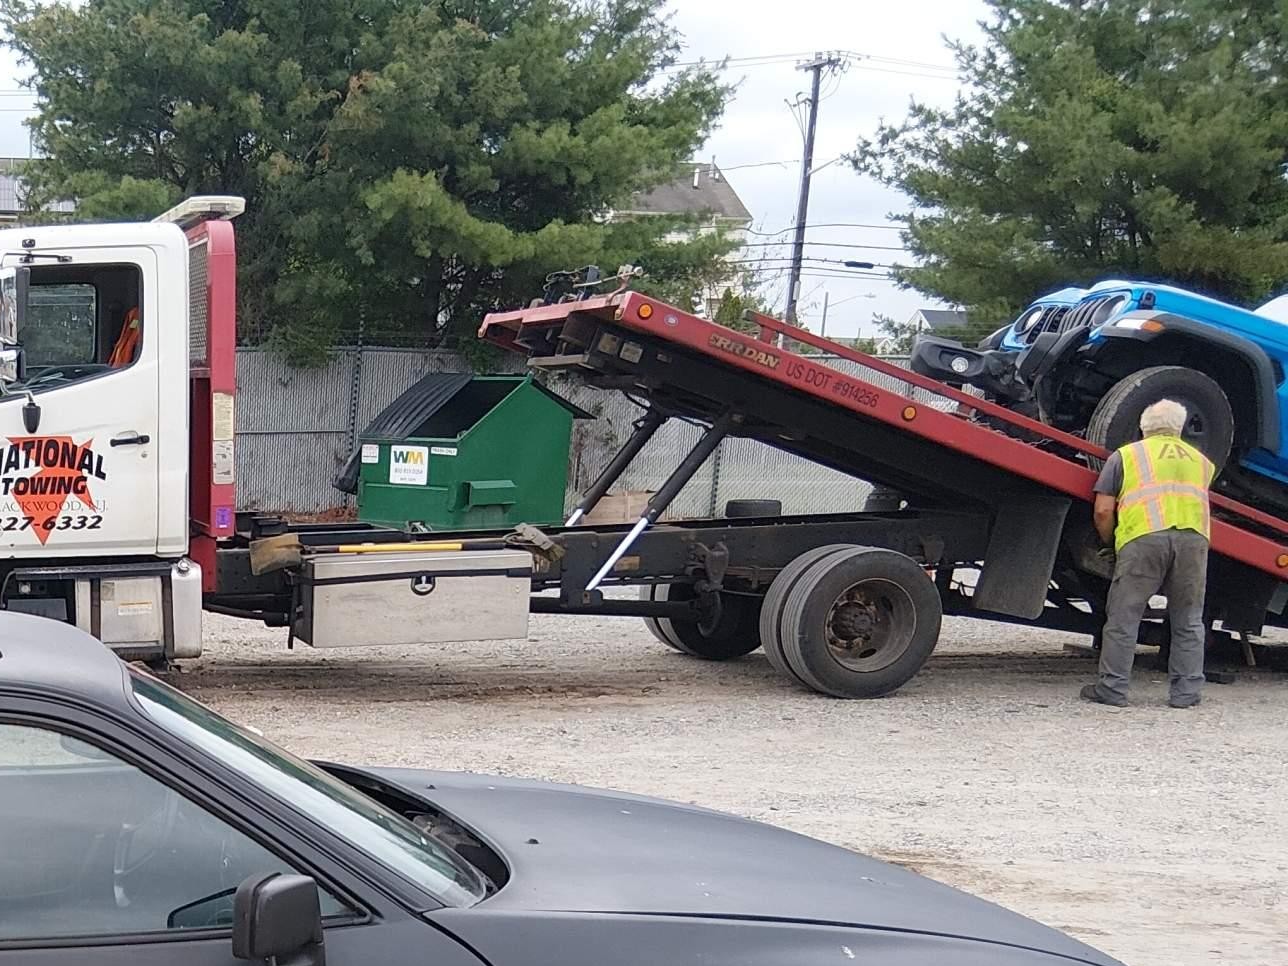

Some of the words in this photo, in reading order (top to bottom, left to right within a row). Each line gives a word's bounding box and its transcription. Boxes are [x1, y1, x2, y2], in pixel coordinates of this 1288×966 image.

[786, 361, 805, 379] US
[805, 368, 832, 389] DOT
[832, 381, 880, 408] #914256
[393, 450, 424, 464] WM
[2, 476, 88, 496] TOWING
